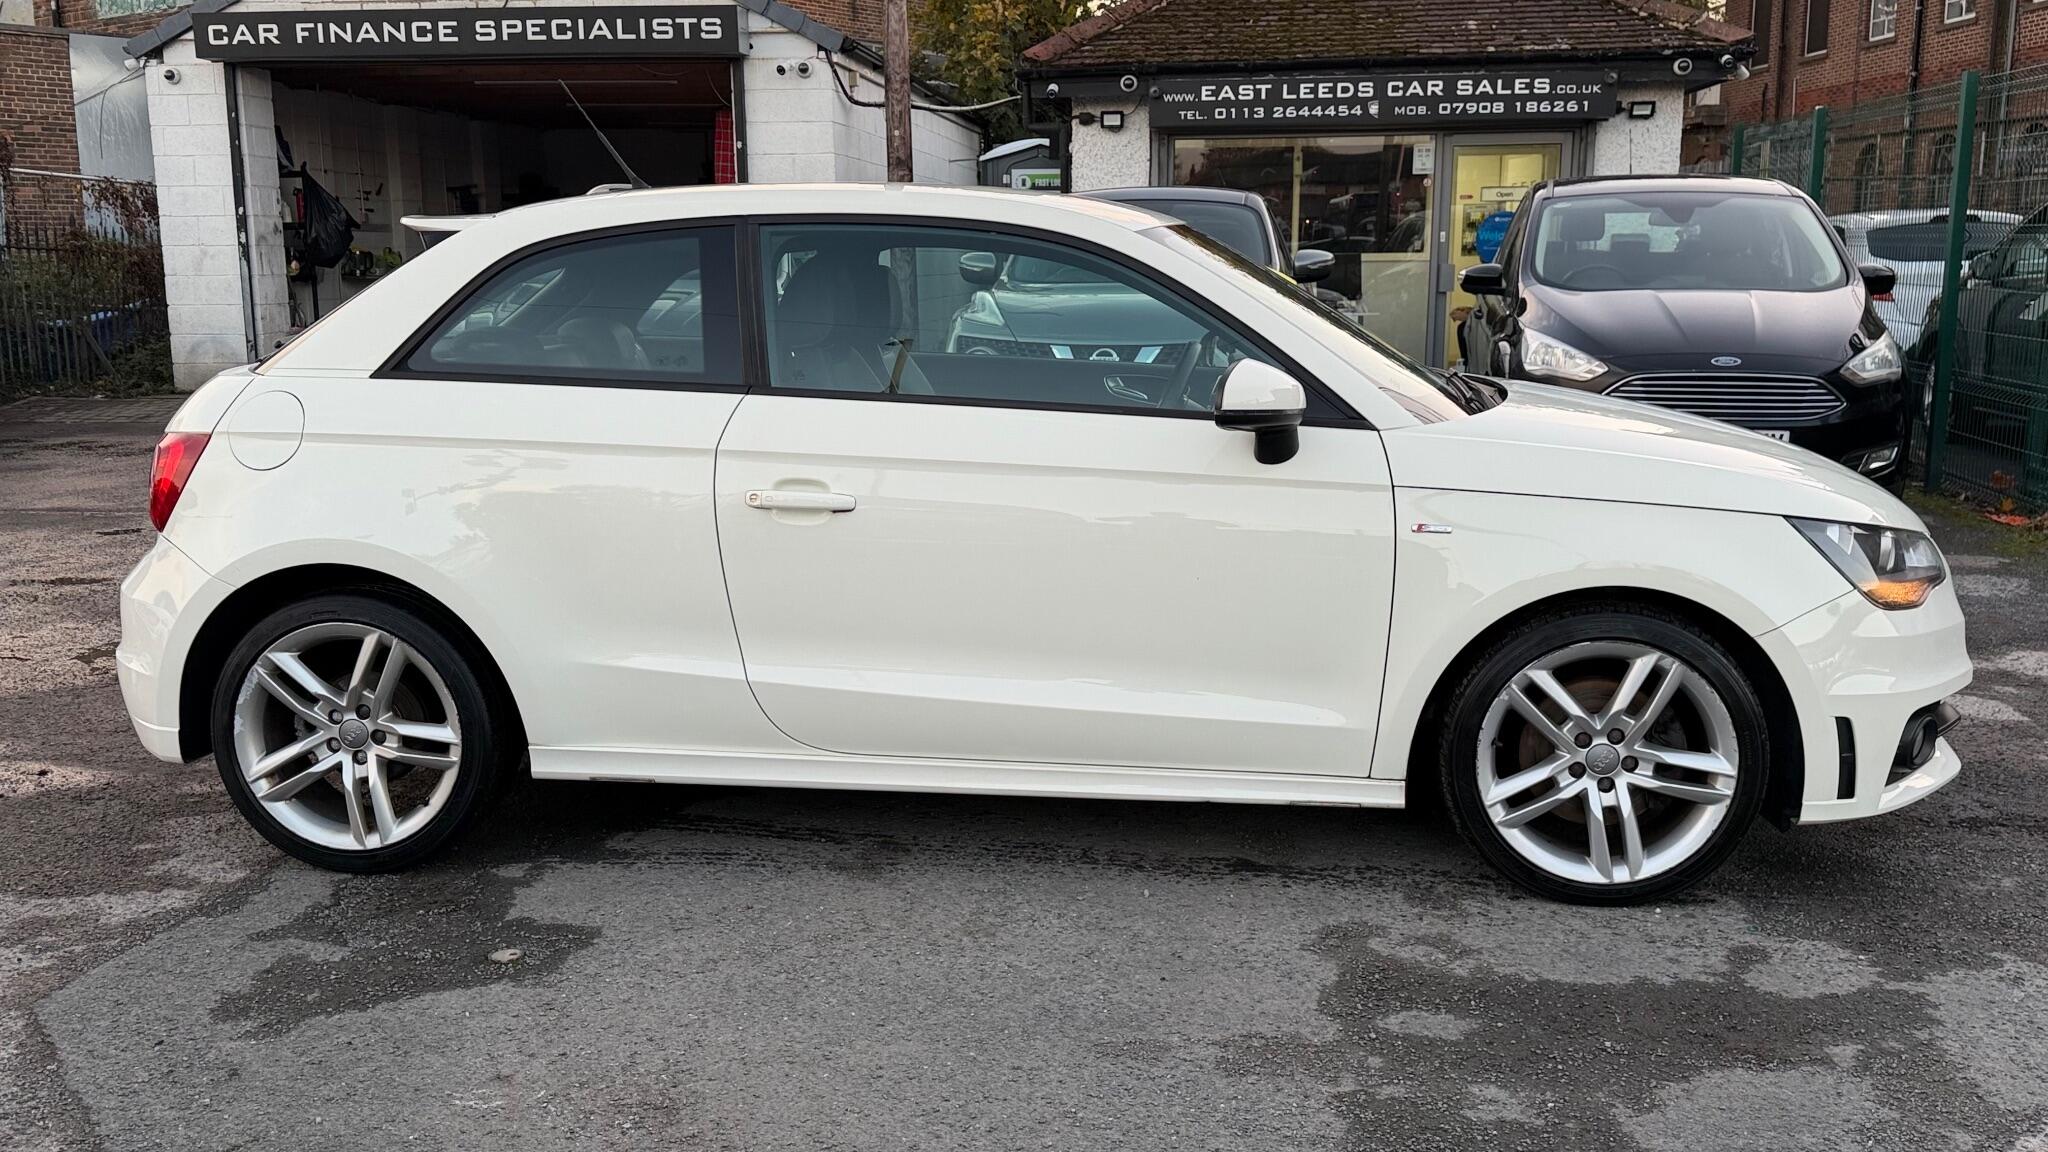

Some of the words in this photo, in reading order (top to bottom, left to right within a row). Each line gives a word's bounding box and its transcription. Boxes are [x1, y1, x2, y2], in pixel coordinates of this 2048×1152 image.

[207, 23, 281, 46] CAR
[295, 21, 459, 44] FINANCE
[474, 17, 722, 42] SPECIALISTS
[1282, 81, 1375, 100] LEEDS
[1387, 80, 1444, 97] CAR
[1178, 110, 1208, 120] TEL.
[1214, 107, 1265, 119] 0113
[1272, 104, 1363, 118] 2644454
[1394, 105, 1431, 116] MOB.
[1438, 102, 1505, 115] 07908
[1515, 100, 1590, 113] 186261
[1496, 190, 1514, 198] Open
[1479, 230, 1505, 240] Welc
